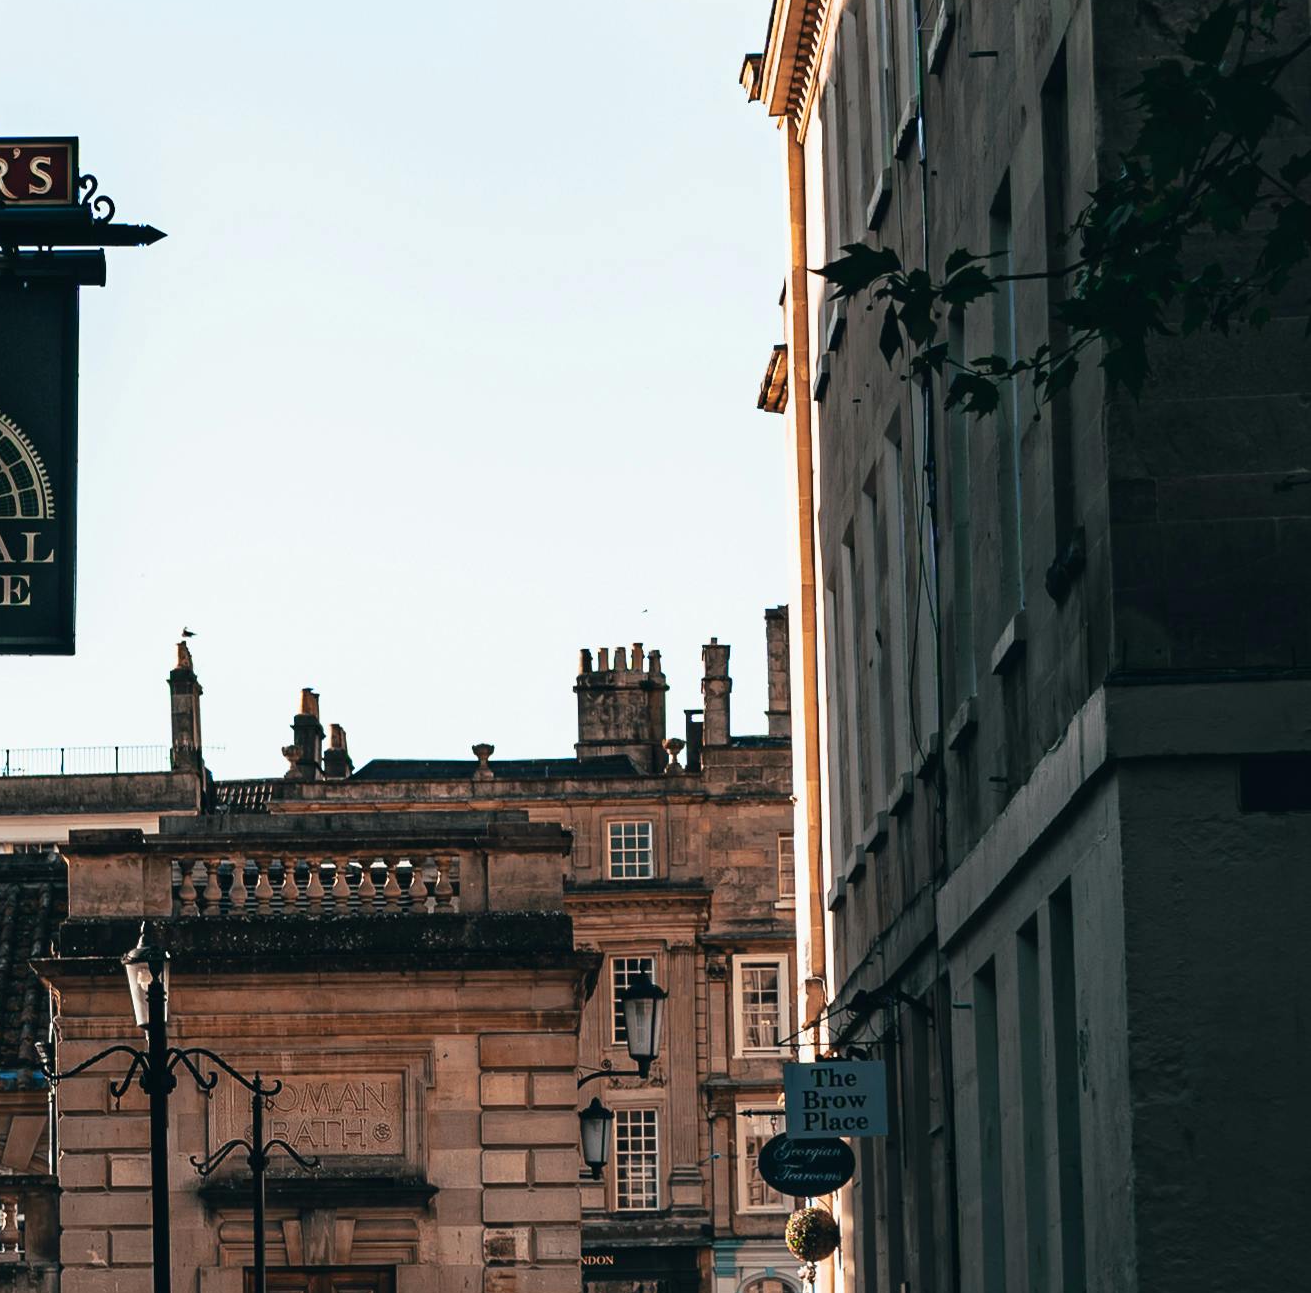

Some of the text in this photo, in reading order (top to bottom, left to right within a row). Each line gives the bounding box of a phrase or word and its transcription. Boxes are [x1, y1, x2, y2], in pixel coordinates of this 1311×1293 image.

[810, 1068, 857, 1087] The
[802, 1090, 867, 1109] Brow
[803, 1112, 869, 1131] Place
[270, 1118, 367, 1148] BATH
[773, 1139, 841, 1163] Georgian
[774, 1164, 842, 1181] Tearooms
[581, 1255, 614, 1265] NDON
